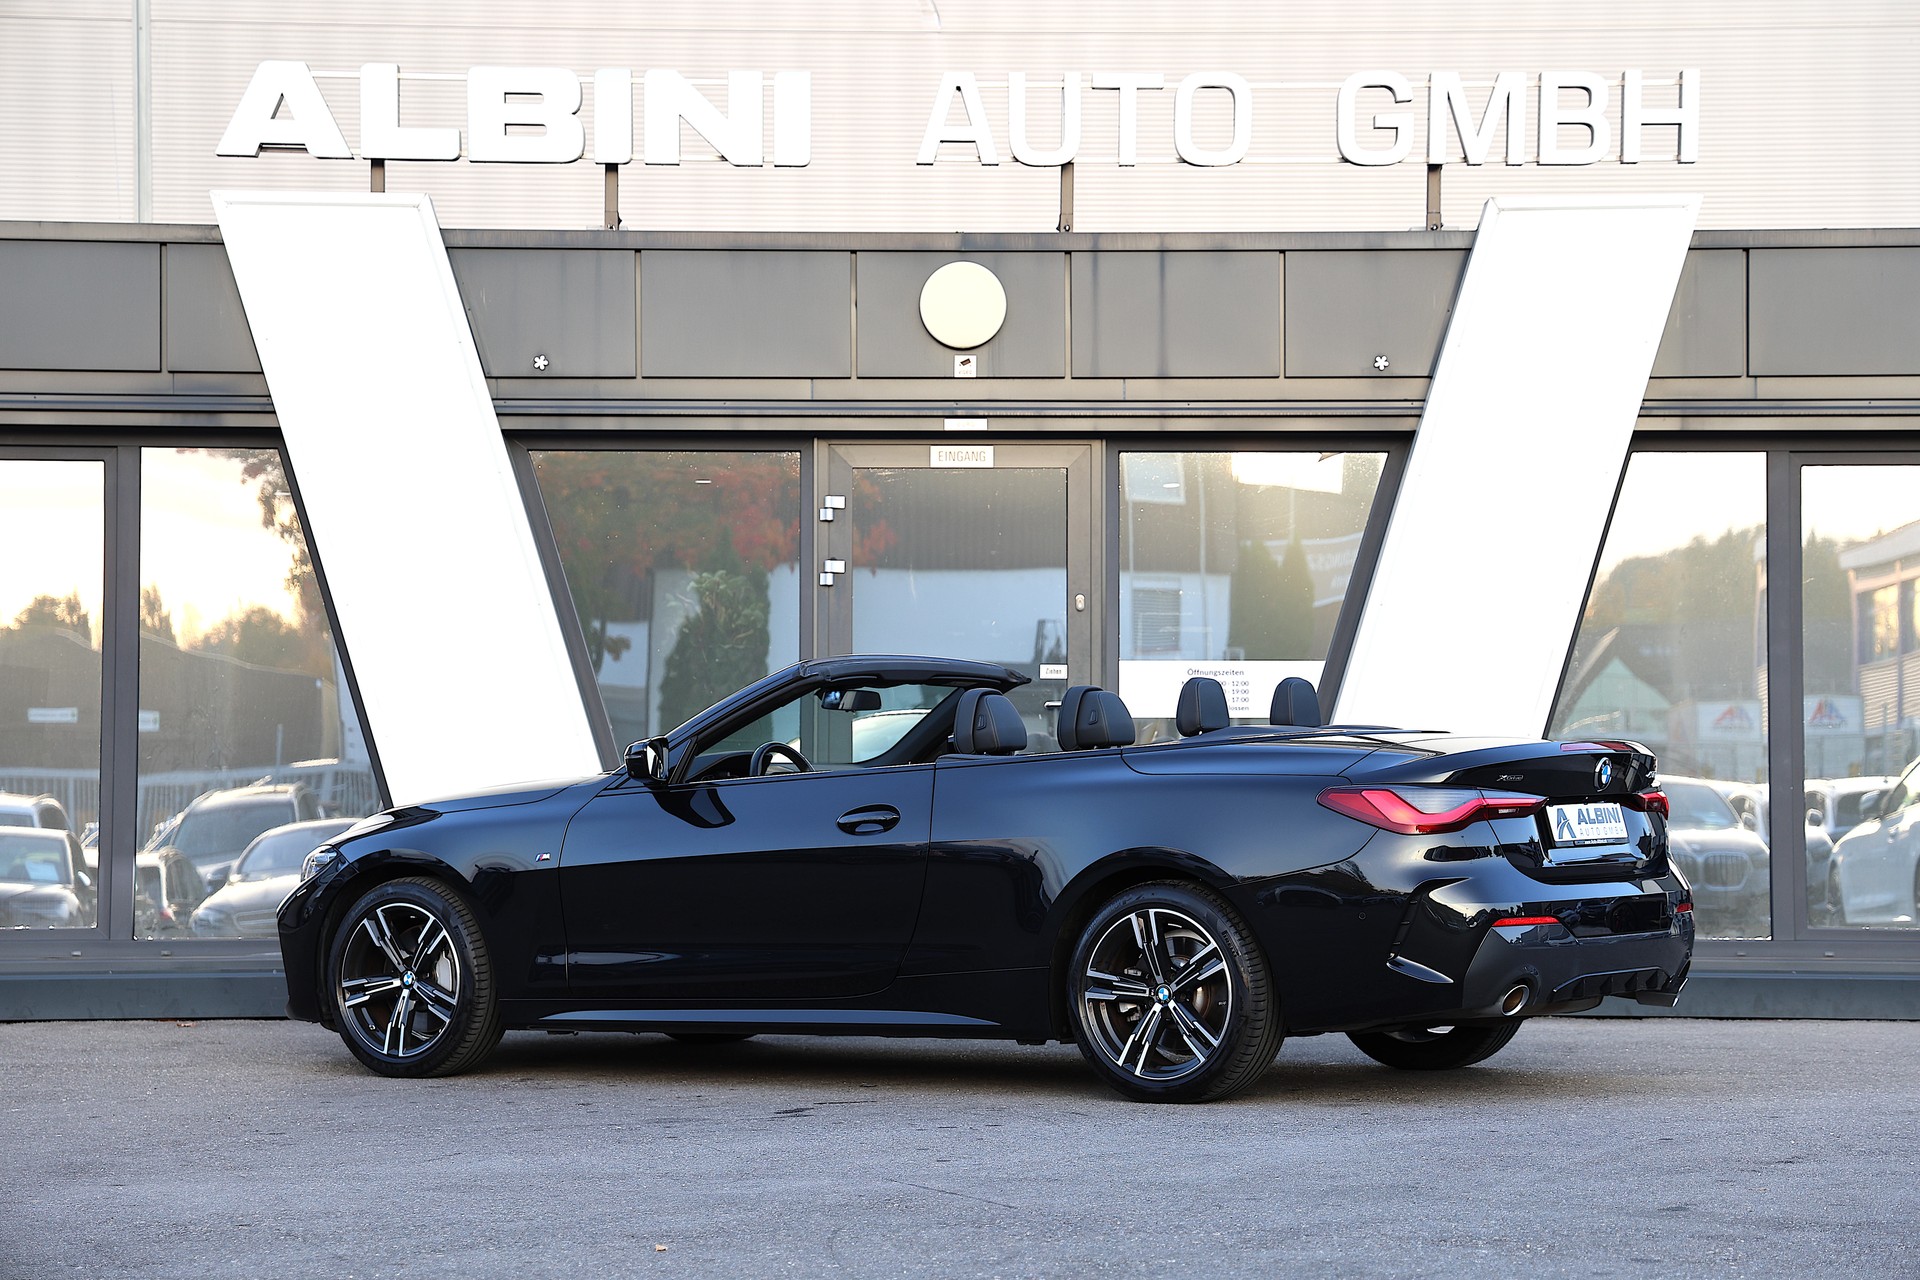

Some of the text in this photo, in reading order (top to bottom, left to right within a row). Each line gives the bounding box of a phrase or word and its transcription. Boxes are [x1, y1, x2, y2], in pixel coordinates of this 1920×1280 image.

[216, 60, 1700, 167] ALBINI AUTO GMBH
[938, 450, 987, 463] EINGANG
[1186, 667, 1245, 677] Öffnungszeiten
[1577, 807, 1621, 825] ALBINI
